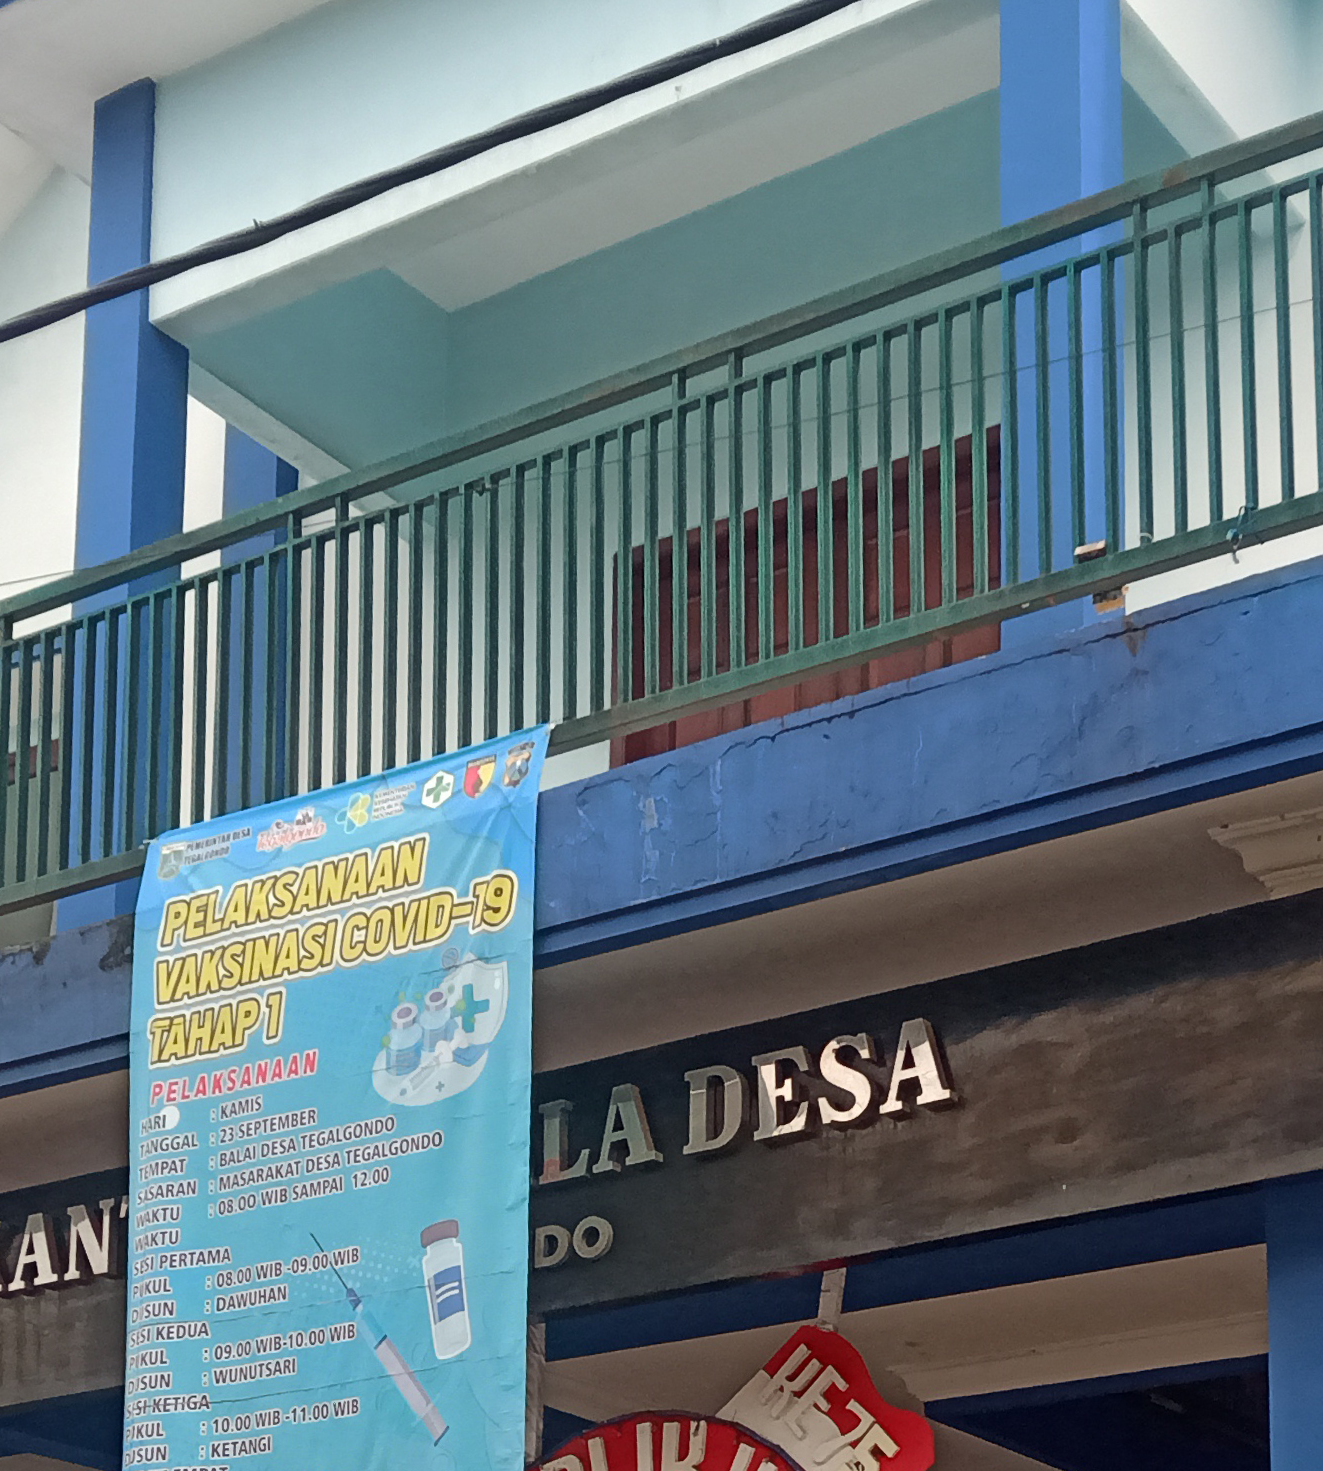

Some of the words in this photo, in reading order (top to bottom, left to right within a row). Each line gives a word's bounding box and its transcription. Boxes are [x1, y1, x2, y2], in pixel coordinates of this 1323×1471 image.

[163, 836, 427, 946] PELAKSANAAN
[157, 923, 334, 1004] VAKSINASI
[342, 874, 515, 961] COVID-19
[151, 1000, 262, 1064] TAHAP
[151, 1050, 317, 1105] PELAKSANAAN
[683, 1018, 956, 1156] DESA
[220, 1096, 262, 1120] KAMIS
[139, 1158, 186, 1181] TEMPAT
[219, 1146, 256, 1167] BALAI
[261, 1138, 297, 1158] DESA
[301, 1117, 395, 1150] TEGALGONDO
[140, 1133, 198, 1159] TANGGAL
[220, 1128, 235, 1144] 23
[239, 1109, 317, 1139] SEPTEMBER
[137, 1180, 197, 1206] SASARAN
[219, 1160, 301, 1192] MASARAKAT
[305, 1153, 341, 1173] DESA
[345, 1131, 443, 1166] TEGALGONDO
[136, 1206, 180, 1229] WAKTU
[218, 1195, 256, 1216] 08.00
[261, 1188, 288, 1207] WIB
[292, 1176, 343, 1201] SAMPAI
[352, 1167, 389, 1188] 12.00
[135, 1230, 179, 1252] WAKTU
[159, 1248, 231, 1269] PERTAMA
[216, 1268, 252, 1288] 08.00
[256, 1262, 282, 1278] WIB
[333, 1248, 359, 1266] WIB
[216, 1286, 287, 1312] DAWUHAN
[156, 1323, 209, 1341] KEDUA
[215, 1341, 251, 1360] 09.00
[330, 1324, 356, 1342] WIB
[214, 1358, 296, 1385] WUNUTSARI
[152, 1395, 210, 1414] KETIGA
[213, 1416, 251, 1434] 10.00
[255, 1411, 280, 1428] WIB
[333, 1399, 359, 1417] WIB
[211, 1436, 272, 1458] KETANGI
